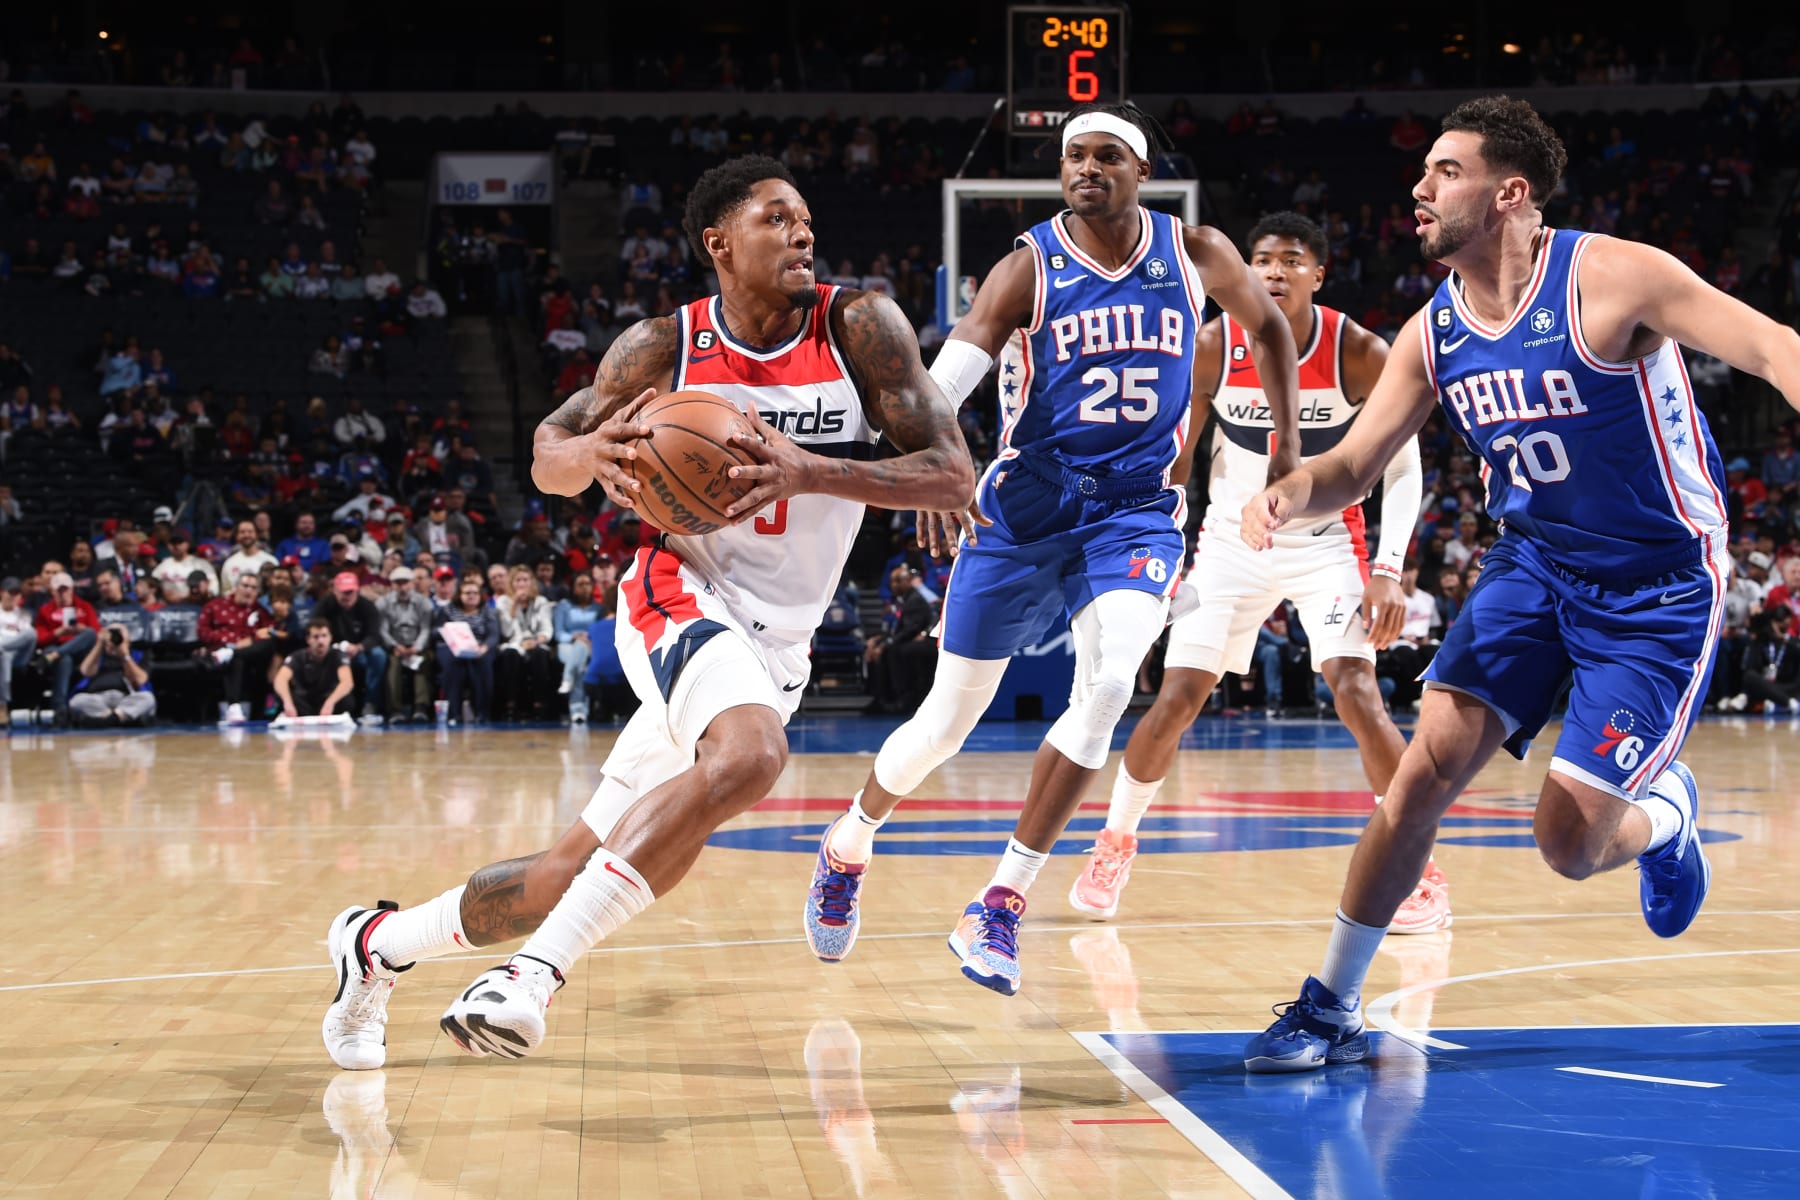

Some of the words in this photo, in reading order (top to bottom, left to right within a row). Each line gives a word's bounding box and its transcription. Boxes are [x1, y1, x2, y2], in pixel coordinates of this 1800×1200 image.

[1043, 17, 1108, 48] 2:40
[1068, 50, 1099, 102] 6
[444, 182, 480, 200] 108
[512, 182, 547, 200] 107
[1051, 255, 1065, 270] 6
[1141, 280, 1179, 290] crypto.com
[1437, 308, 1451, 327] 6
[697, 331, 713, 349] 6
[1050, 304, 1184, 363] PHILA
[1523, 333, 1566, 349] crypto.com
[1233, 346, 1246, 360] 6
[1079, 367, 1159, 424] 25
[1445, 369, 1589, 431] PHILA
[1227, 398, 1334, 422] wizds
[1491, 430, 1572, 493] 20
[1128, 557, 1167, 583] 76
[1592, 722, 1645, 771] 76
